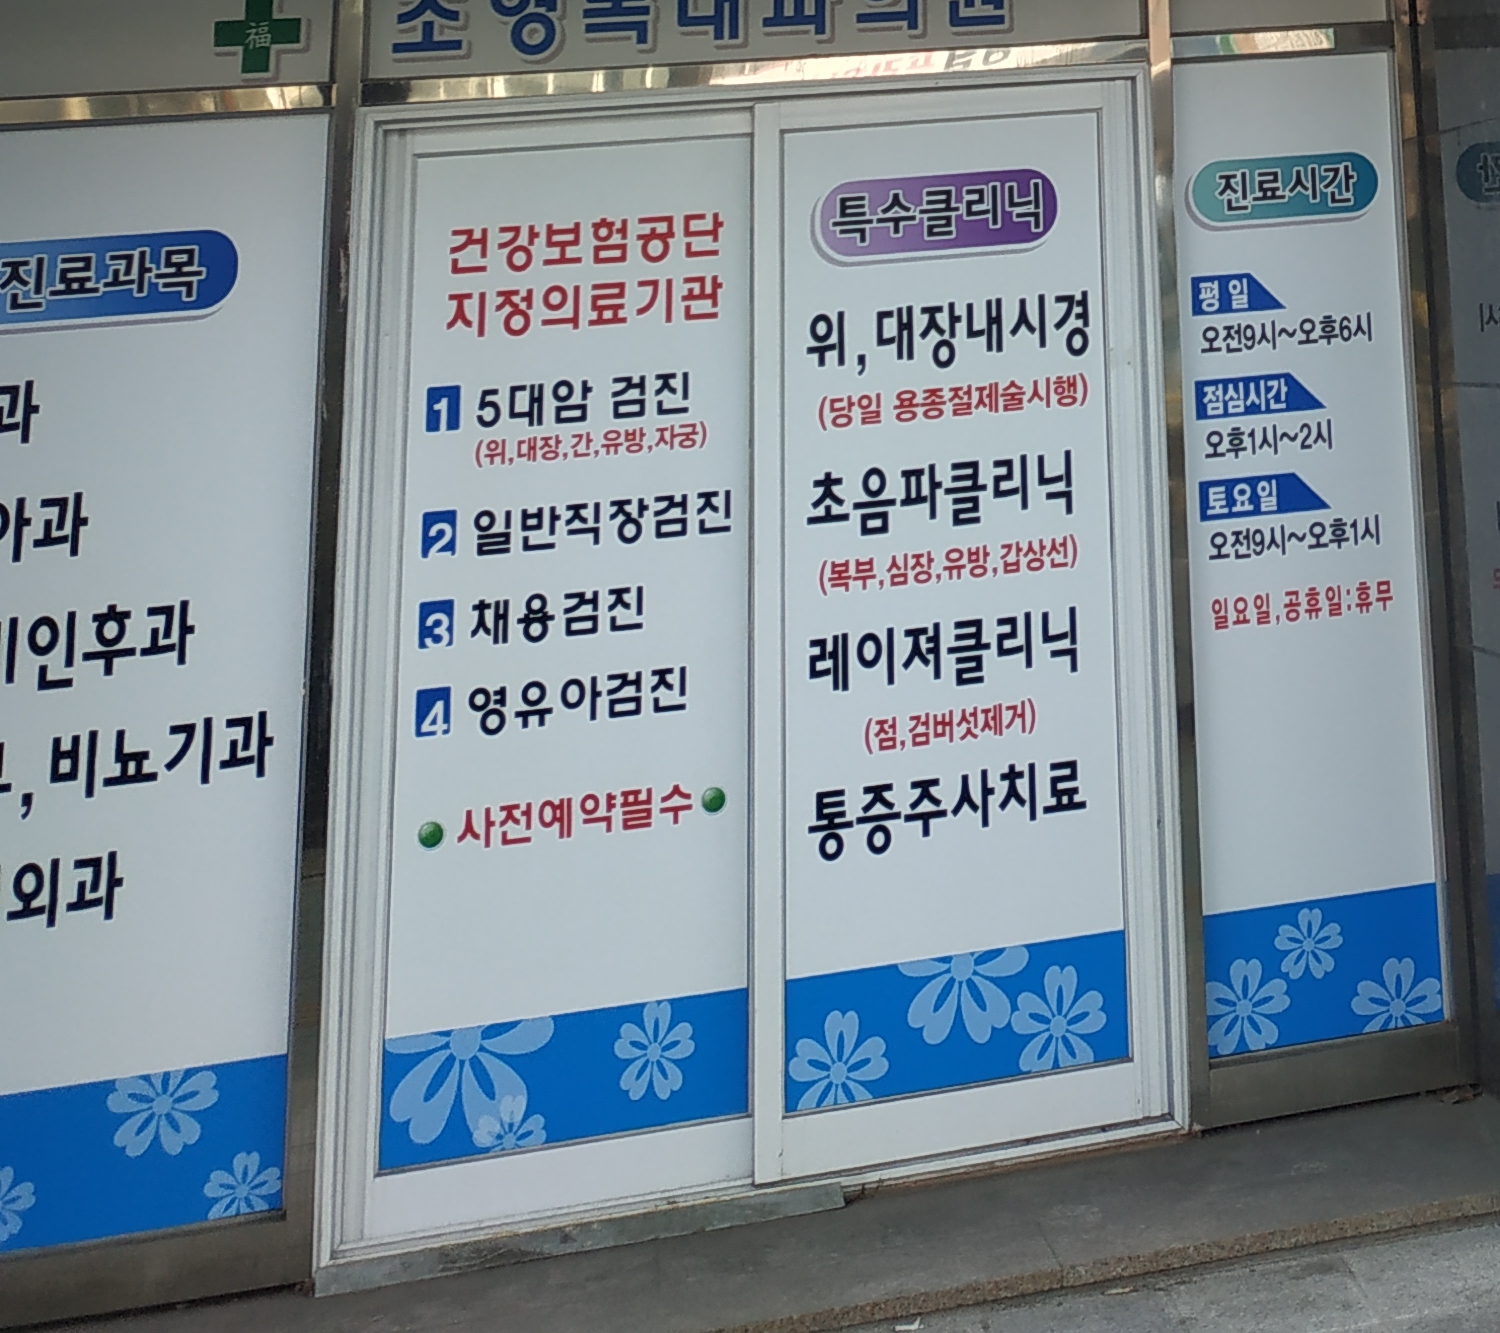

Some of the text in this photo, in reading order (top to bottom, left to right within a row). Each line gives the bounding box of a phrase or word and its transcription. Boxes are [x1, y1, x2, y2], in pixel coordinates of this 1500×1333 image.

[831, 179, 1044, 245] 특수클리닉
[1215, 161, 1357, 214] 진료시간
[449, 212, 724, 275] 건강보험공단
[1, 243, 204, 312] 진료과목
[446, 275, 723, 337] 지정의료기관
[806, 290, 1090, 375] 위,대장내시경
[1200, 311, 1372, 355] 오전9시~오후6시
[475, 379, 593, 427] 5대암
[611, 372, 690, 419] 검진
[818, 373, 1089, 431] (당일 용종절제술시행)
[1203, 378, 1288, 416] 점심시간
[475, 421, 708, 468] (위,대장,간,유방,자궁)
[1204, 418, 1333, 460] 오후1시~2시
[474, 489, 732, 556] 일반직장검진
[806, 449, 1074, 536] 초음파클리닉
[1207, 479, 1278, 516] 토요일
[819, 534, 1078, 596] (복부,심장,유방,갑상선)
[1208, 514, 1381, 561] 오전9시~오후1시
[0, 600, 196, 691] 인후과
[470, 585, 645, 645] 채용검진
[809, 606, 1078, 692] 레이져클리닉
[468, 666, 687, 736] 영유아검진
[864, 698, 1037, 755] (점,검버섯제거)
[457, 784, 693, 848] 사전예약필수
[807, 759, 1087, 861] 통증주사치료
[7, 851, 123, 928] 외과
